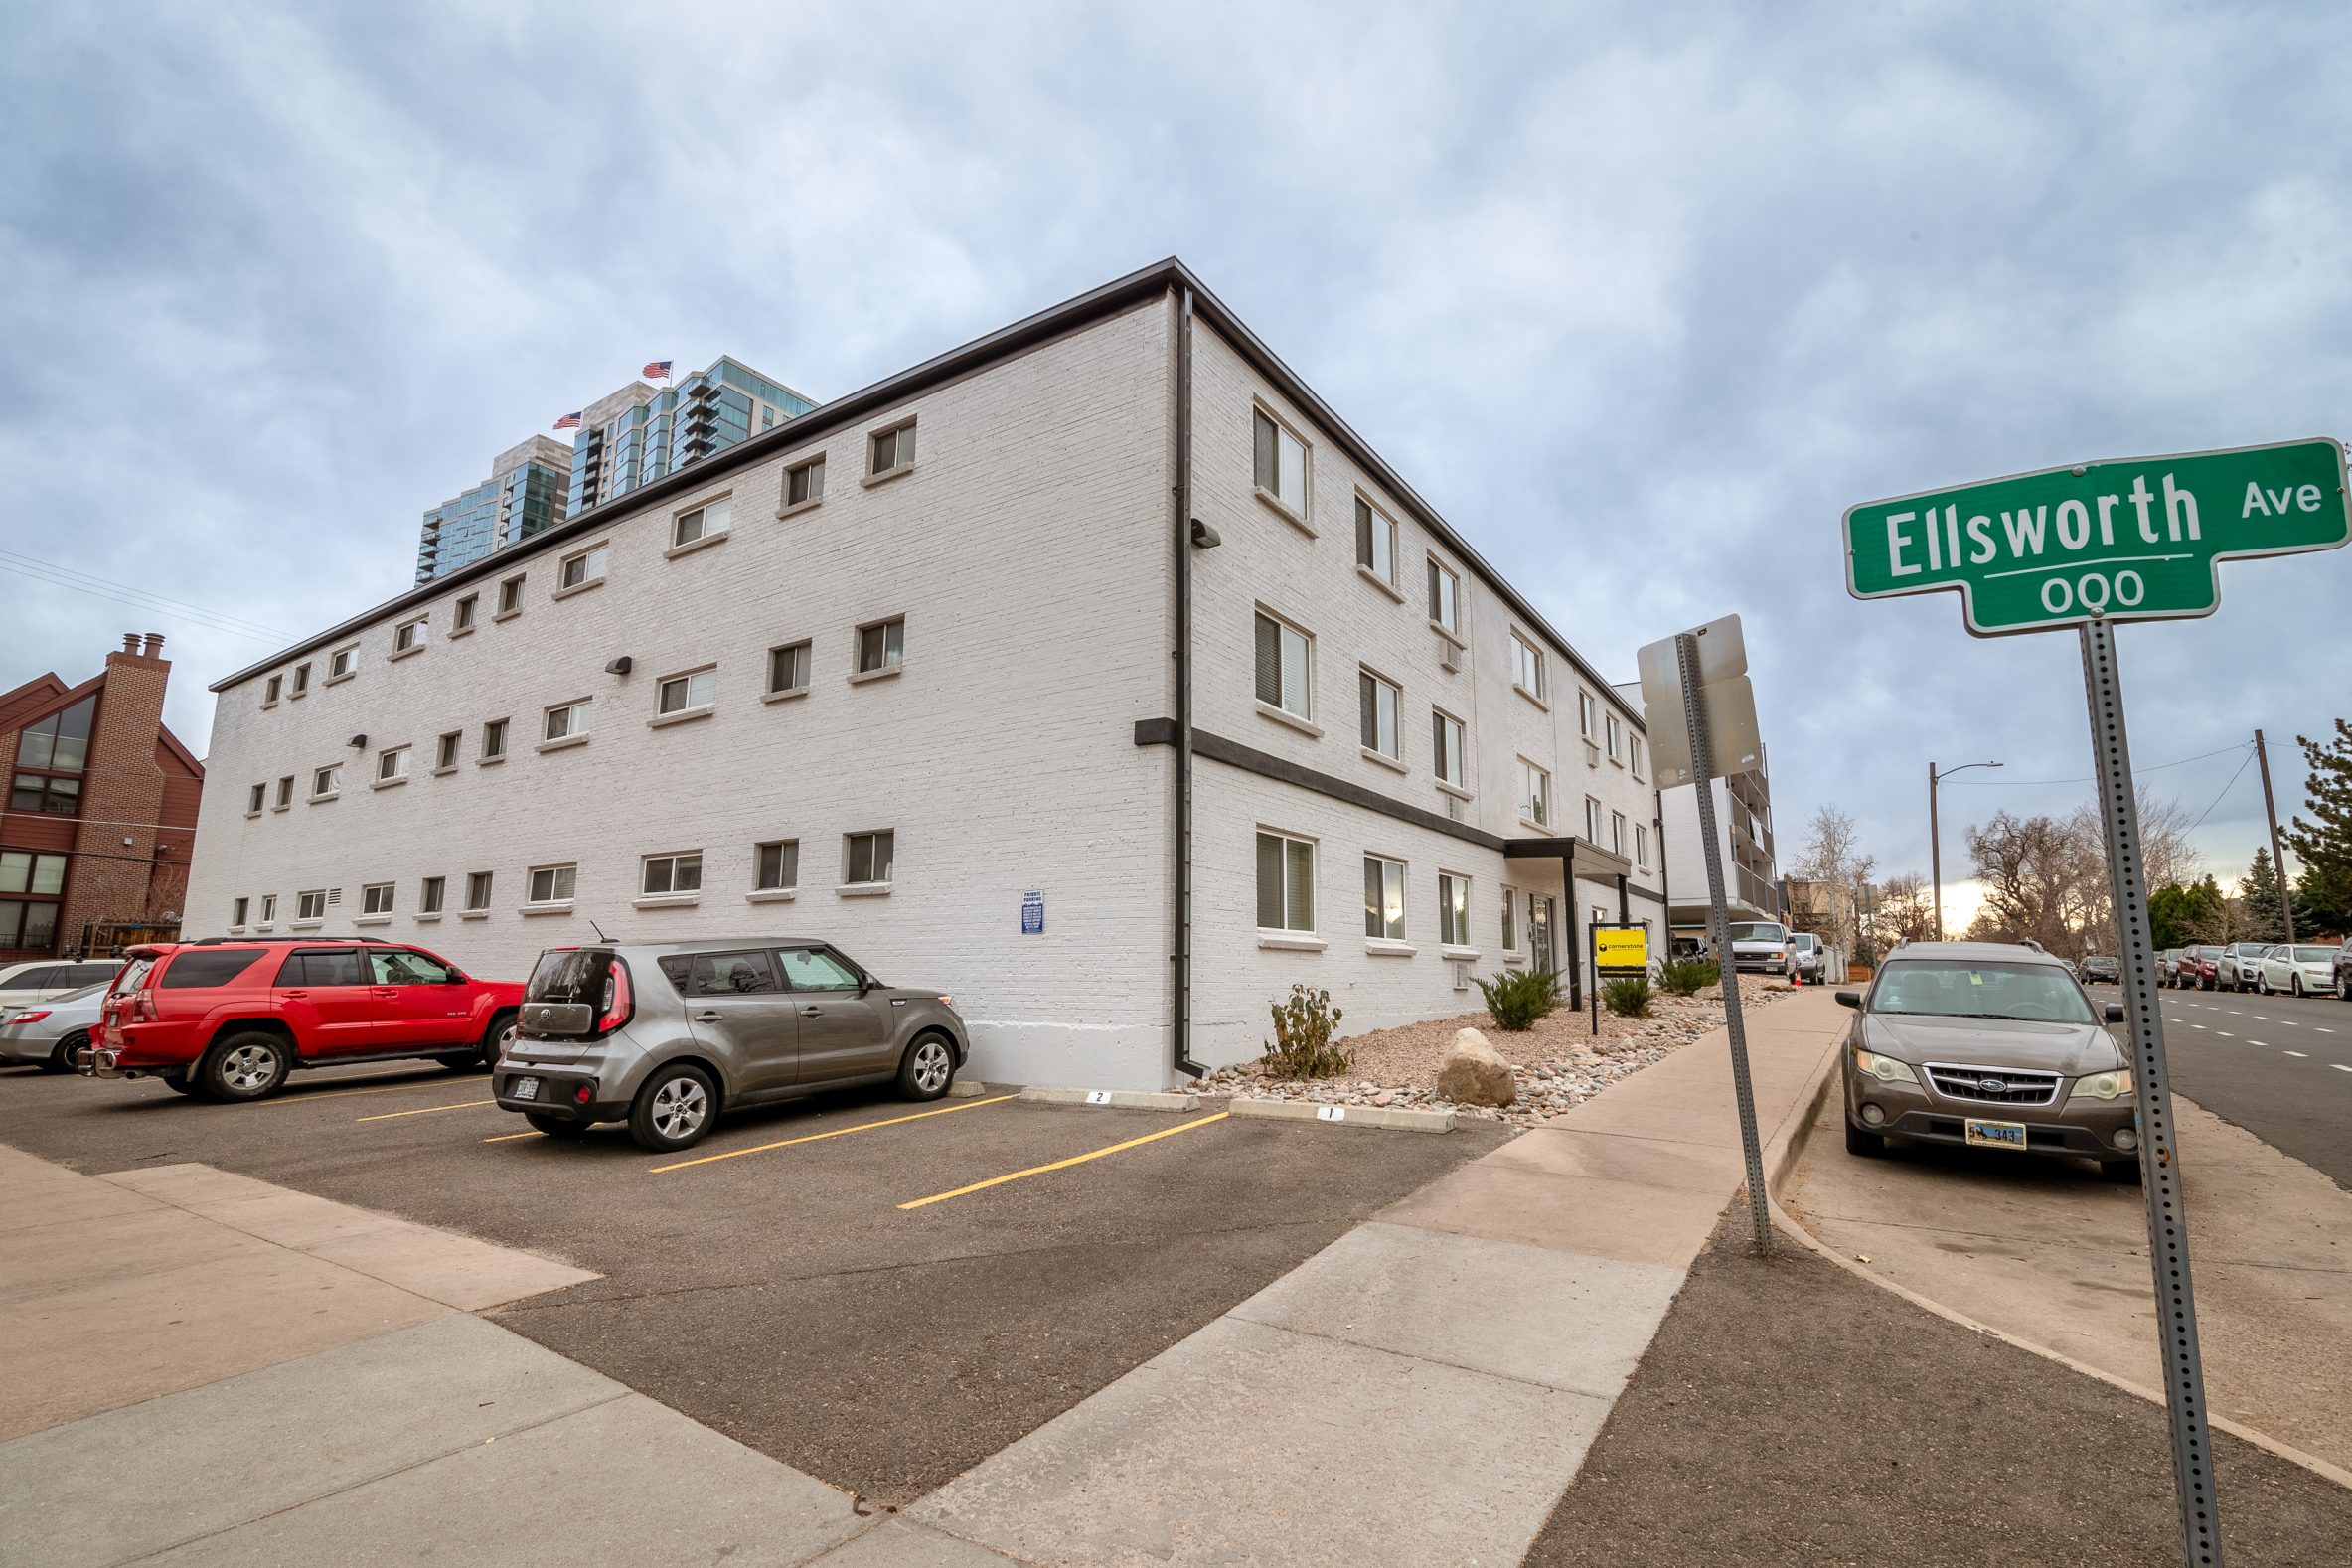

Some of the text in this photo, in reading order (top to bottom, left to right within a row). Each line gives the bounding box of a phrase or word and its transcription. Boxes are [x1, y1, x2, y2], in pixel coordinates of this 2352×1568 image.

[1886, 472, 2322, 577] Ellsworth Ave
[1096, 1092, 1104, 1102] 2
[1329, 1107, 1333, 1119] 1
[1995, 1129, 2015, 1143] 343
